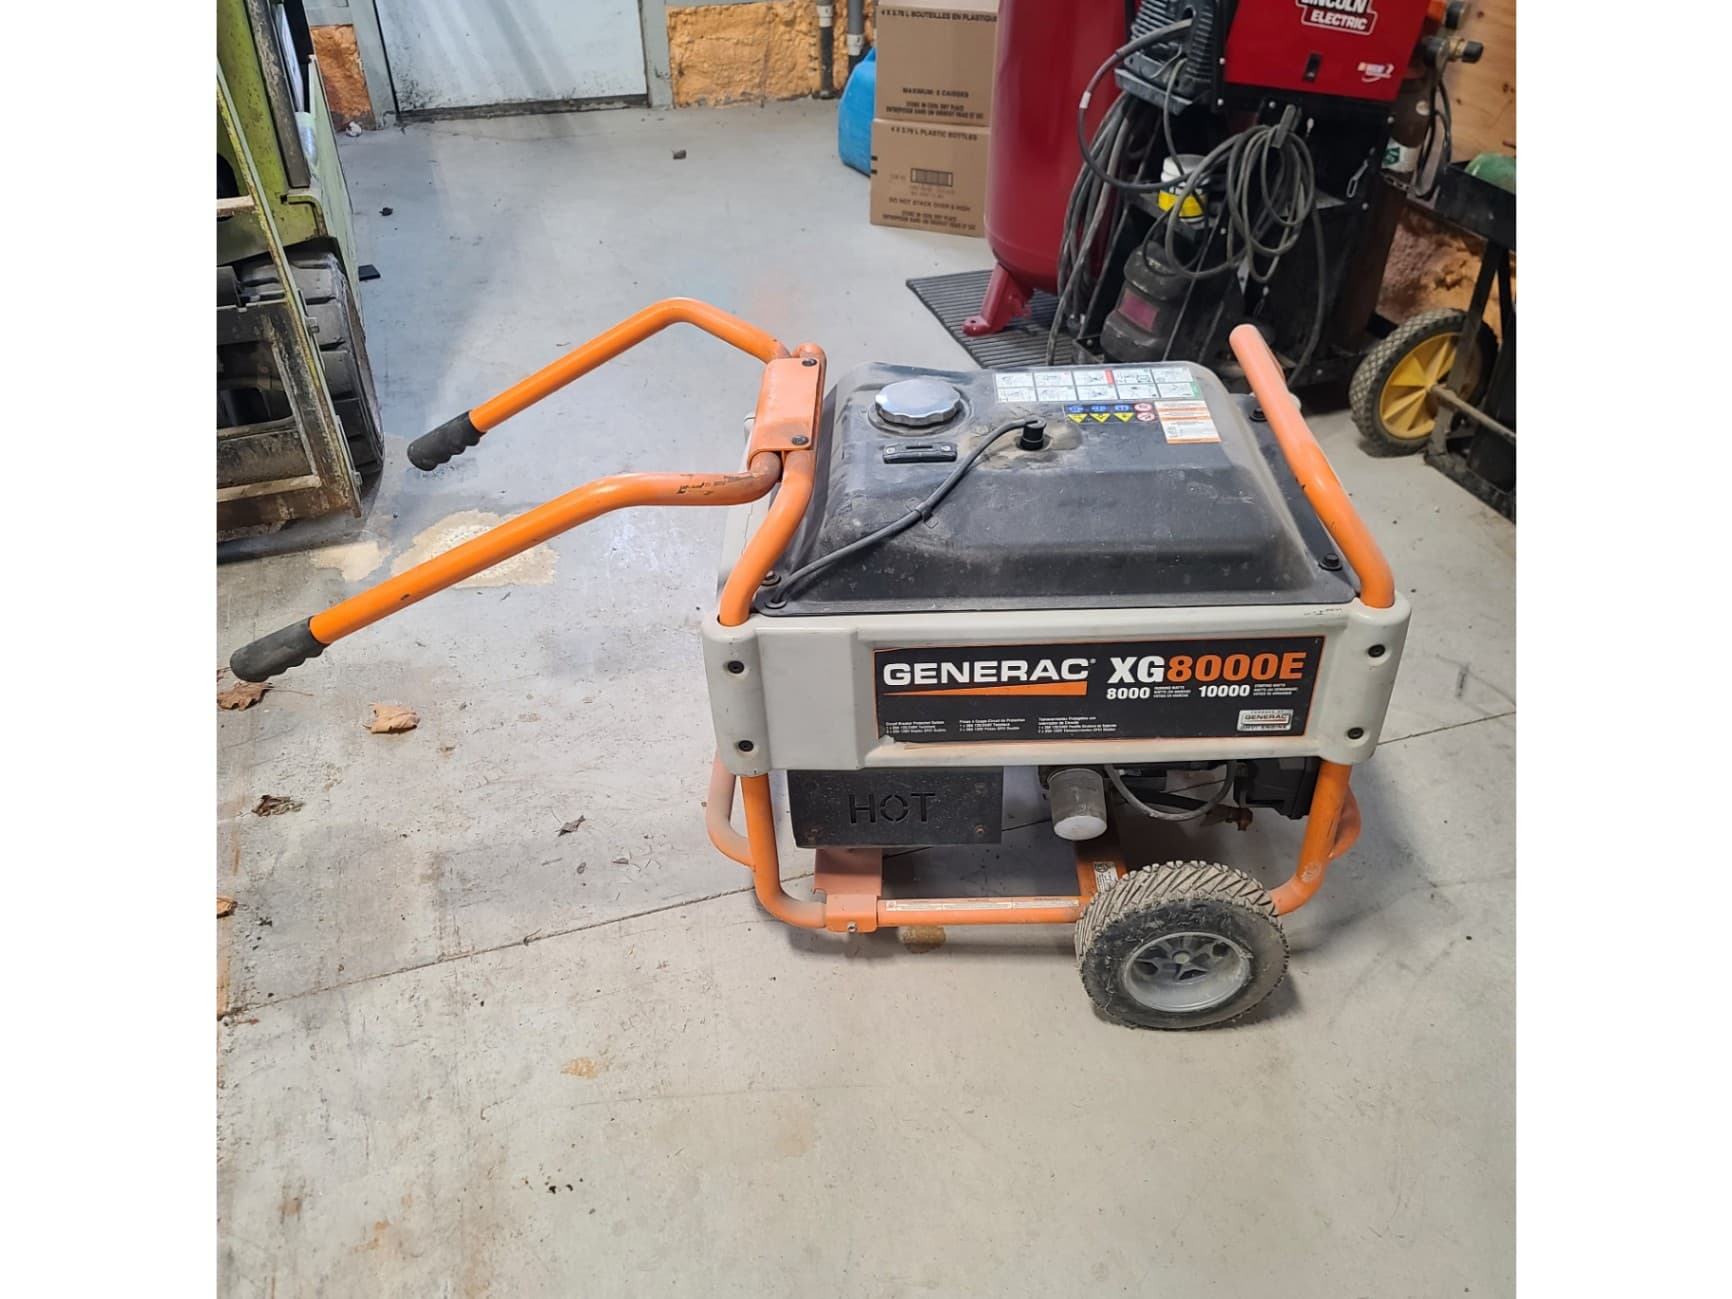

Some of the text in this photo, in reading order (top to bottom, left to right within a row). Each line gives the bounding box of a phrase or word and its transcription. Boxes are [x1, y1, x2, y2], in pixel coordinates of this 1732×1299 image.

[1300, 0, 1368, 13] COLN
[1310, 9, 1368, 30] ELECTRIC
[920, 129, 947, 138] PLASTIC
[948, 131, 978, 141] BOTTLES
[883, 652, 1306, 686] GENERAC XG8000E
[1106, 687, 1150, 700] 8000
[1199, 684, 1251, 698] 10000
[850, 792, 936, 824] HOT
